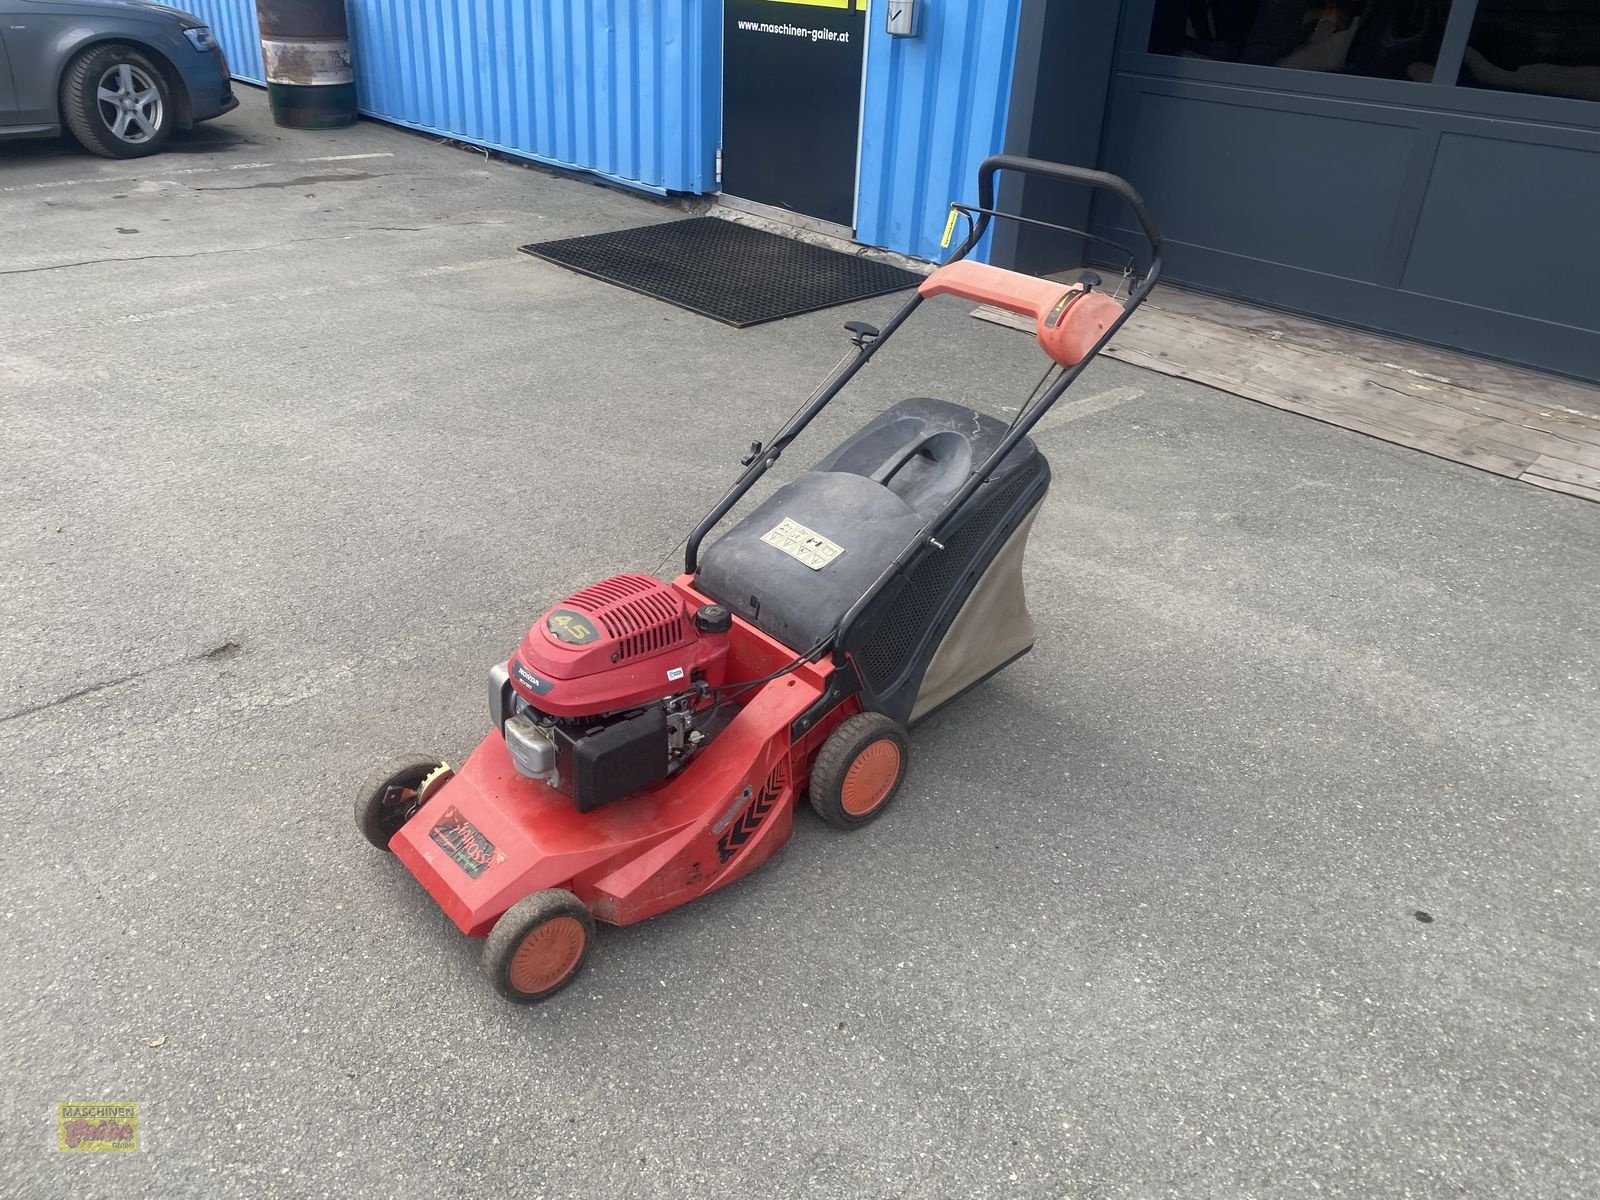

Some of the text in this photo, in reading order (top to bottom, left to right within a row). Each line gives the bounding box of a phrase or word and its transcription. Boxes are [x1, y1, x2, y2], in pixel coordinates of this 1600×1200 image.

[737, 20, 849, 42] www.maschinen-gailer.at
[554, 615, 591, 640] 4.5
[518, 667, 540, 687] HONDA
